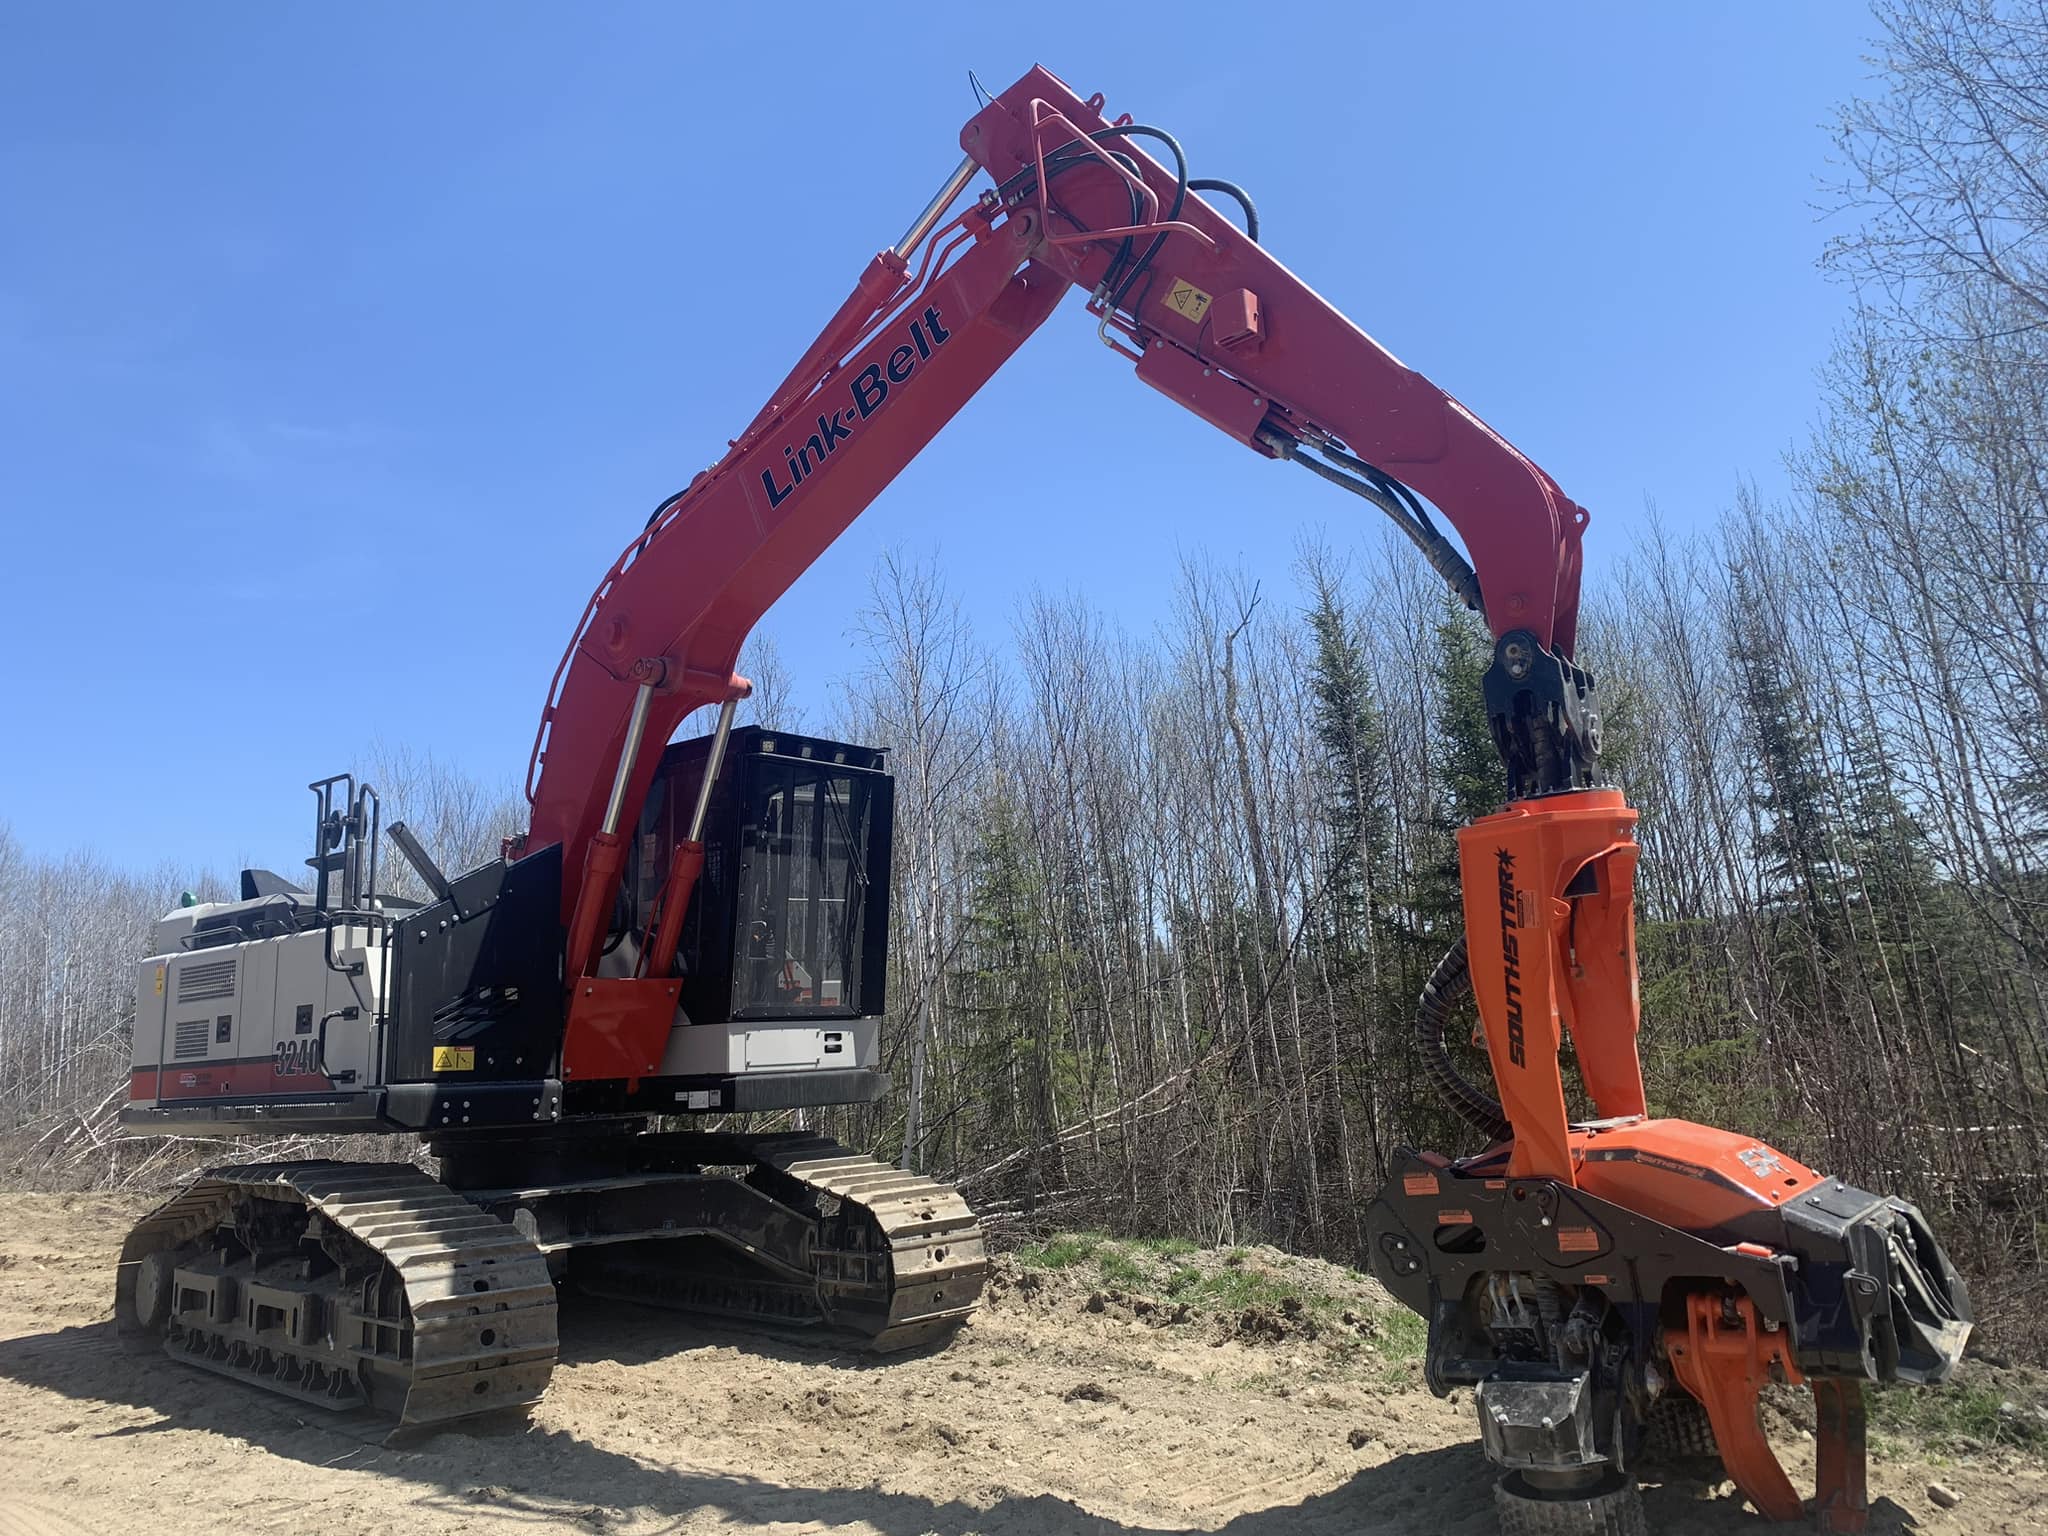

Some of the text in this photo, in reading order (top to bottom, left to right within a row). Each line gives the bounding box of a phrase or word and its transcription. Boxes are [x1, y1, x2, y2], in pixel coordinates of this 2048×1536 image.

[761, 305, 951, 511] Link-Belt
[275, 1038, 320, 1077] 3240
[1497, 864, 1525, 1069] SOUTHSTAR
